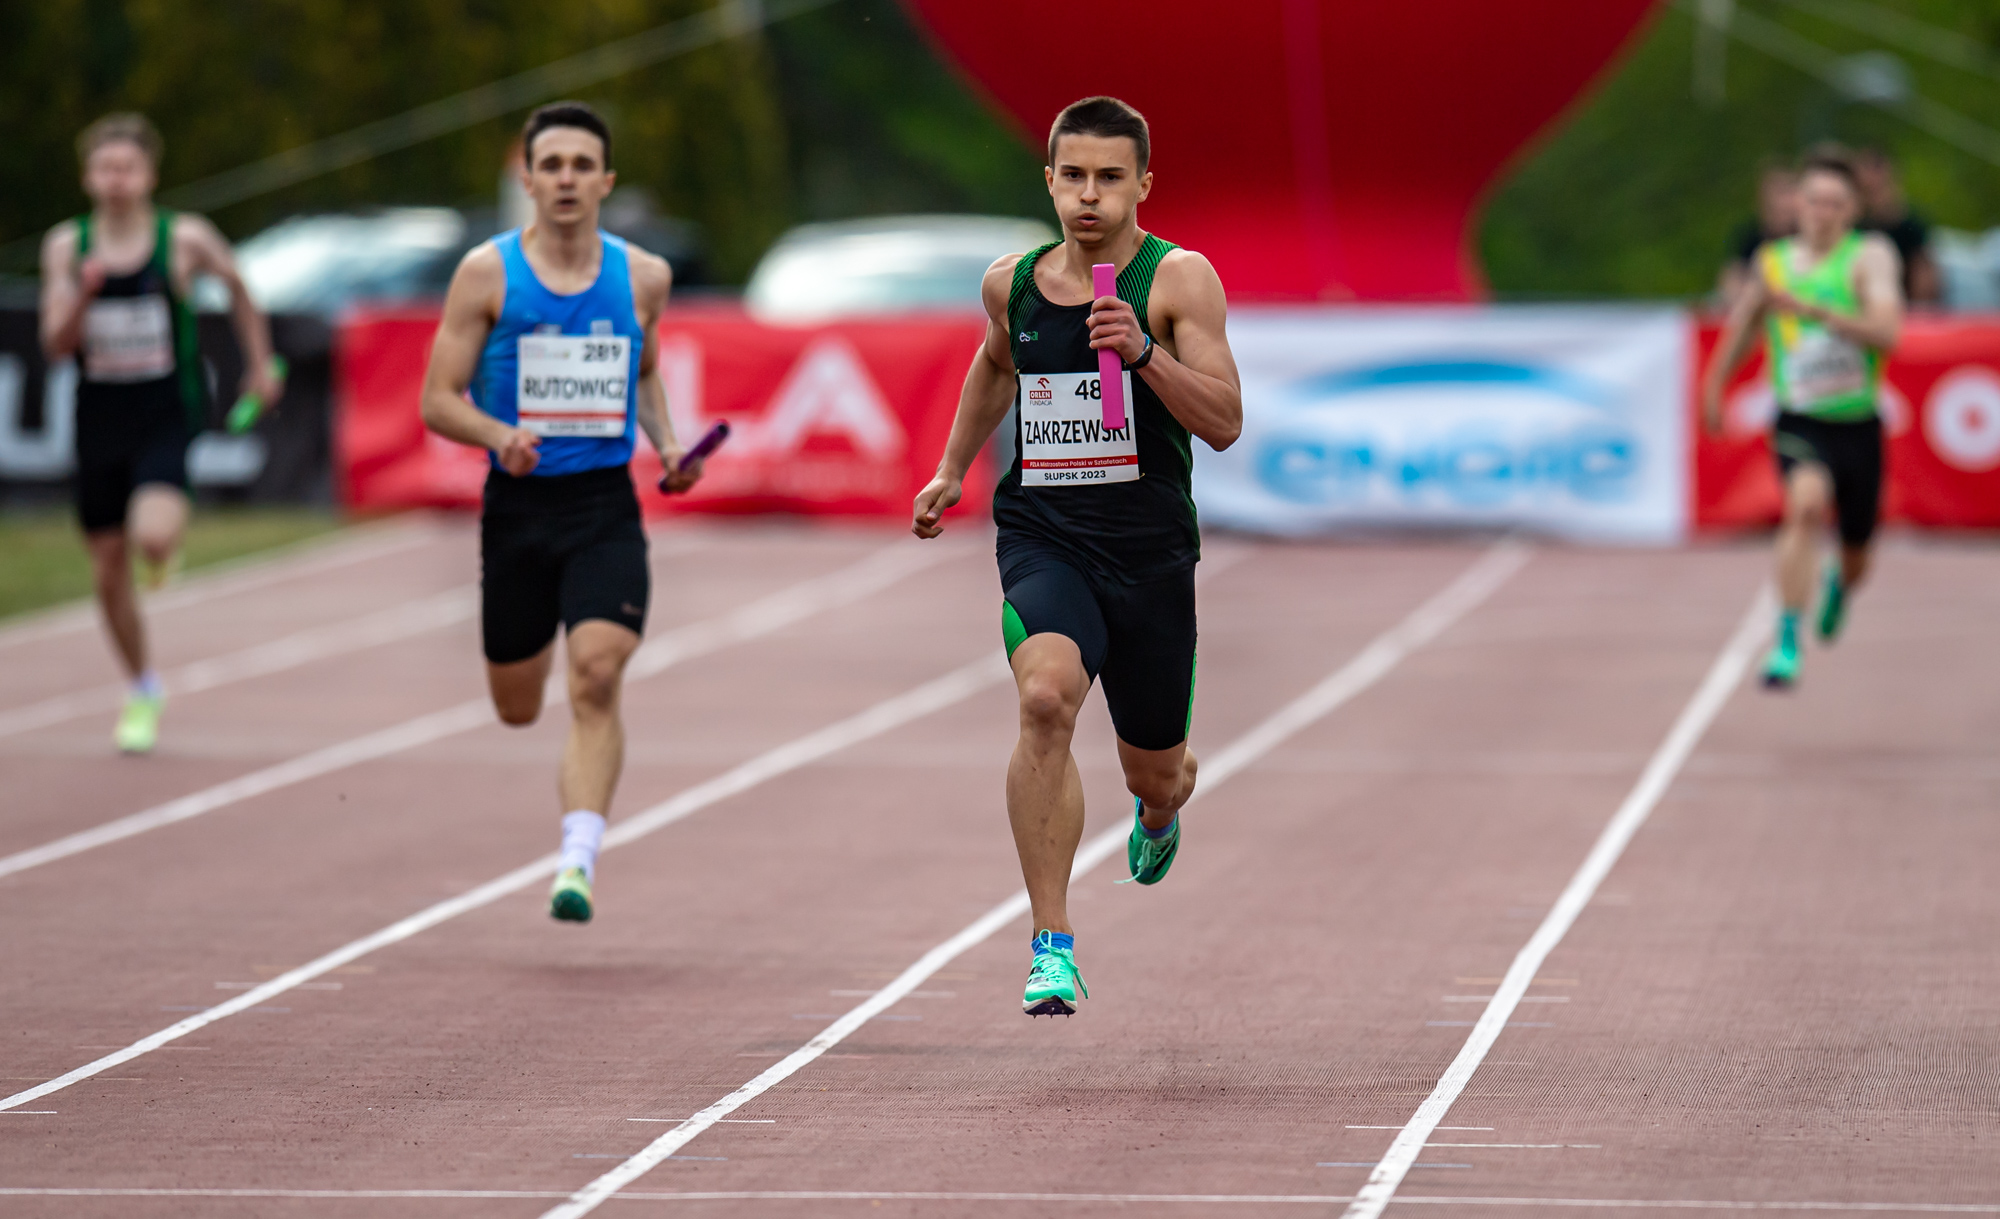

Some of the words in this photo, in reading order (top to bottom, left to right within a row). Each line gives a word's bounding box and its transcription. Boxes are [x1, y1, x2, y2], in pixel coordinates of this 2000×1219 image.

[583, 343, 622, 362] 289
[525, 376, 627, 399] RUTOWICZ
[1030, 391, 1051, 399] ORLEN
[1044, 472, 1078, 480] SŁUPSK
[1081, 470, 1106, 479] 2023
